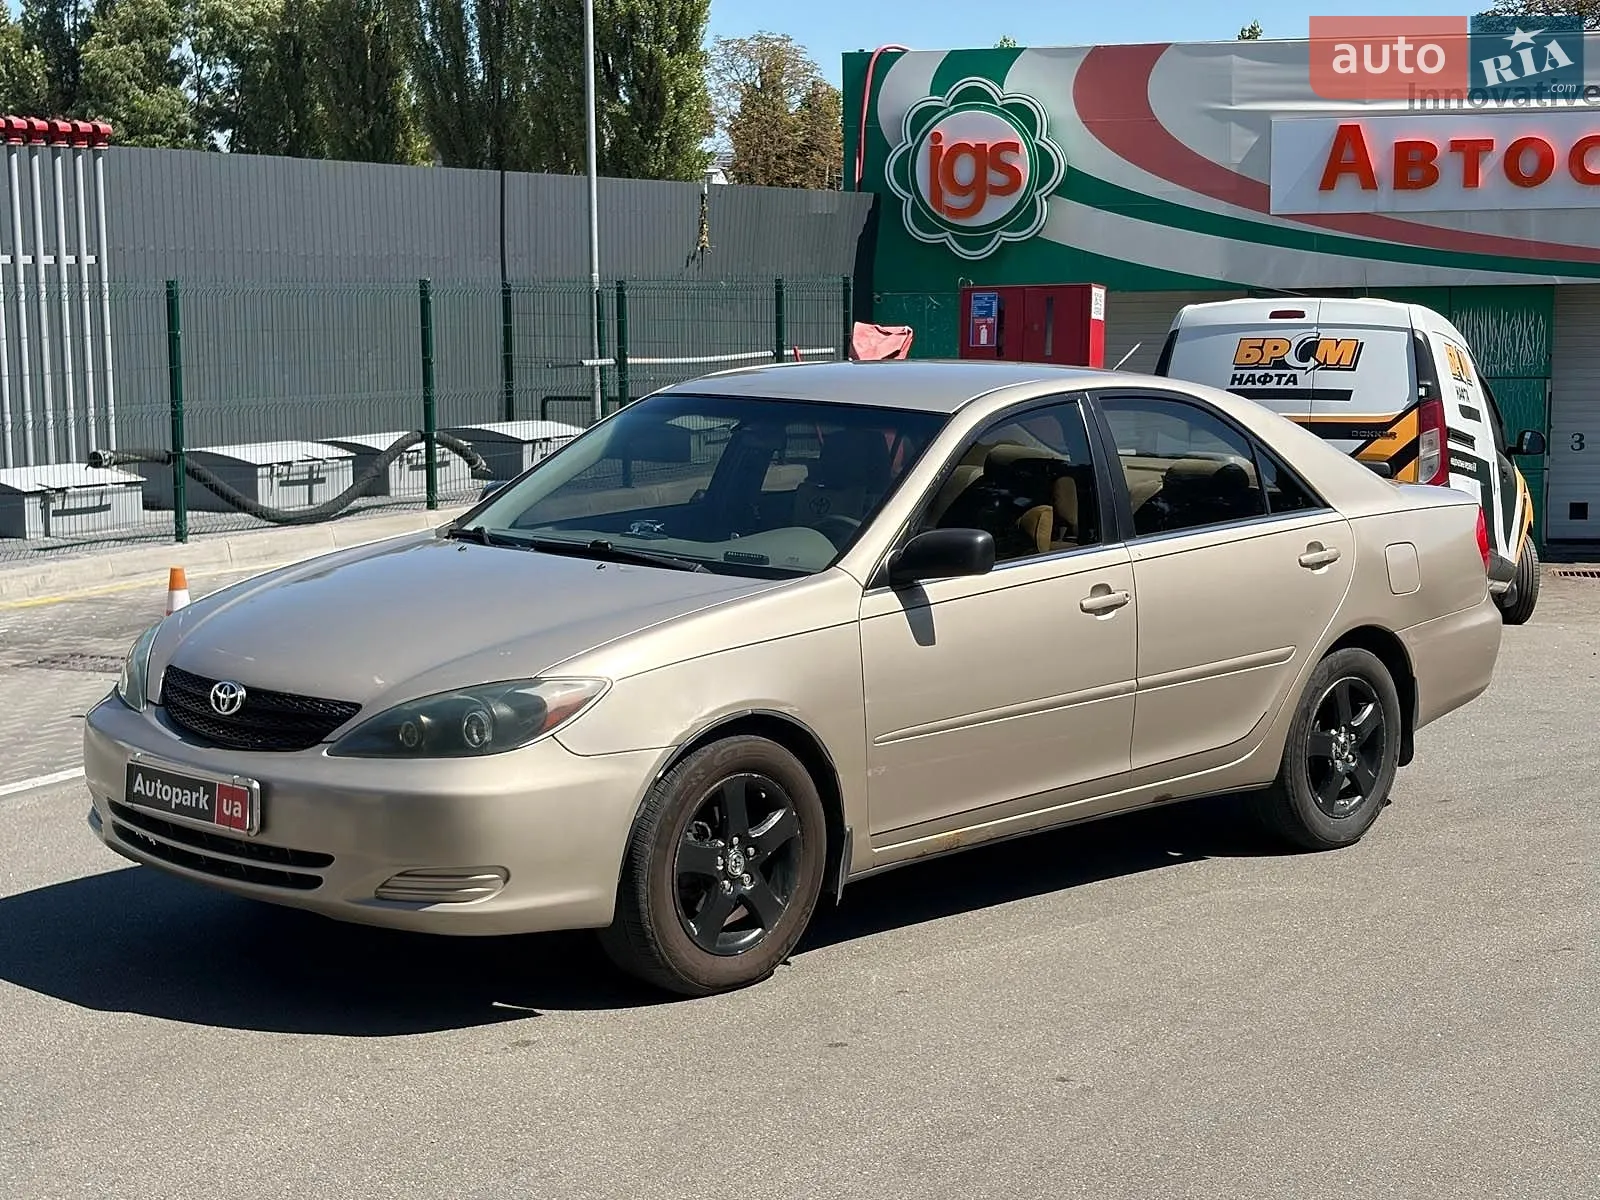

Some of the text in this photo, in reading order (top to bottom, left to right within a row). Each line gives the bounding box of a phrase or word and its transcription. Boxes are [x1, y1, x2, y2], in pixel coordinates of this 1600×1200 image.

[1230, 373, 1298, 386] НАФТА
[1570, 432, 1585, 451] 3
[133, 772, 242, 818] Autopark ua
